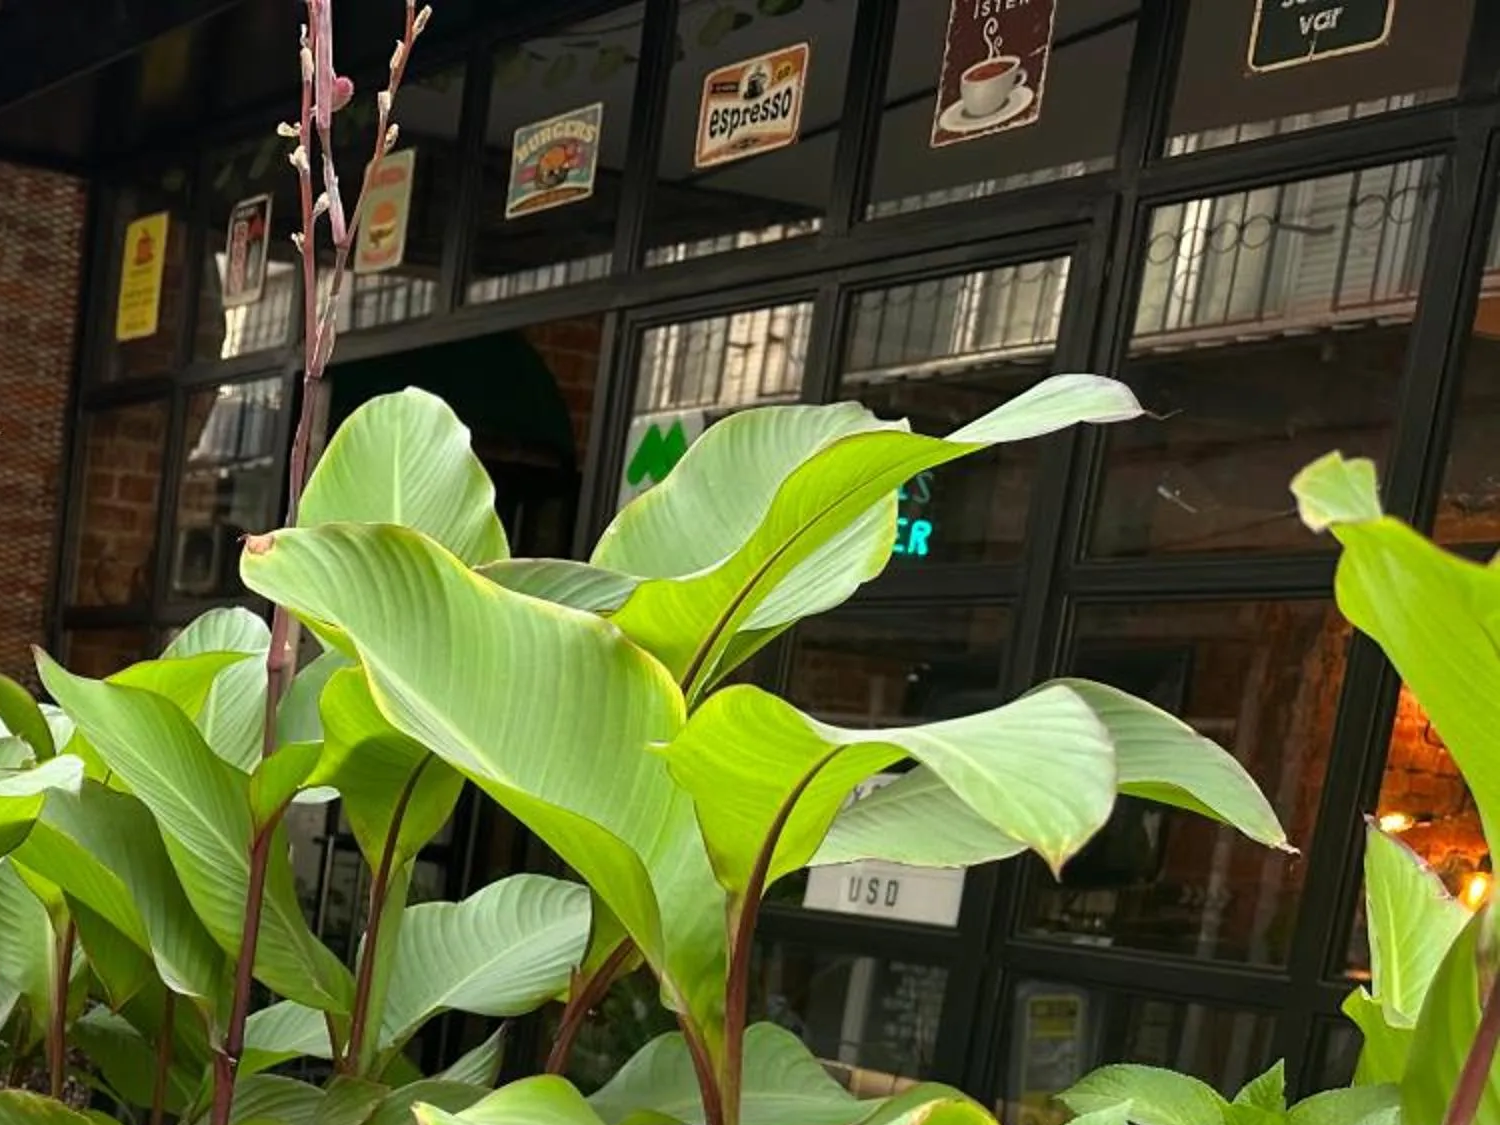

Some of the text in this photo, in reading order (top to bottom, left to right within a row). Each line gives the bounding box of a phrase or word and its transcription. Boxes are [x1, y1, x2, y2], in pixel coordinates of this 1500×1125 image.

[1300, 6, 1344, 35] var
[708, 85, 793, 139] espresso
[516, 120, 597, 164] BURGERS
[848, 875, 900, 908] USD
